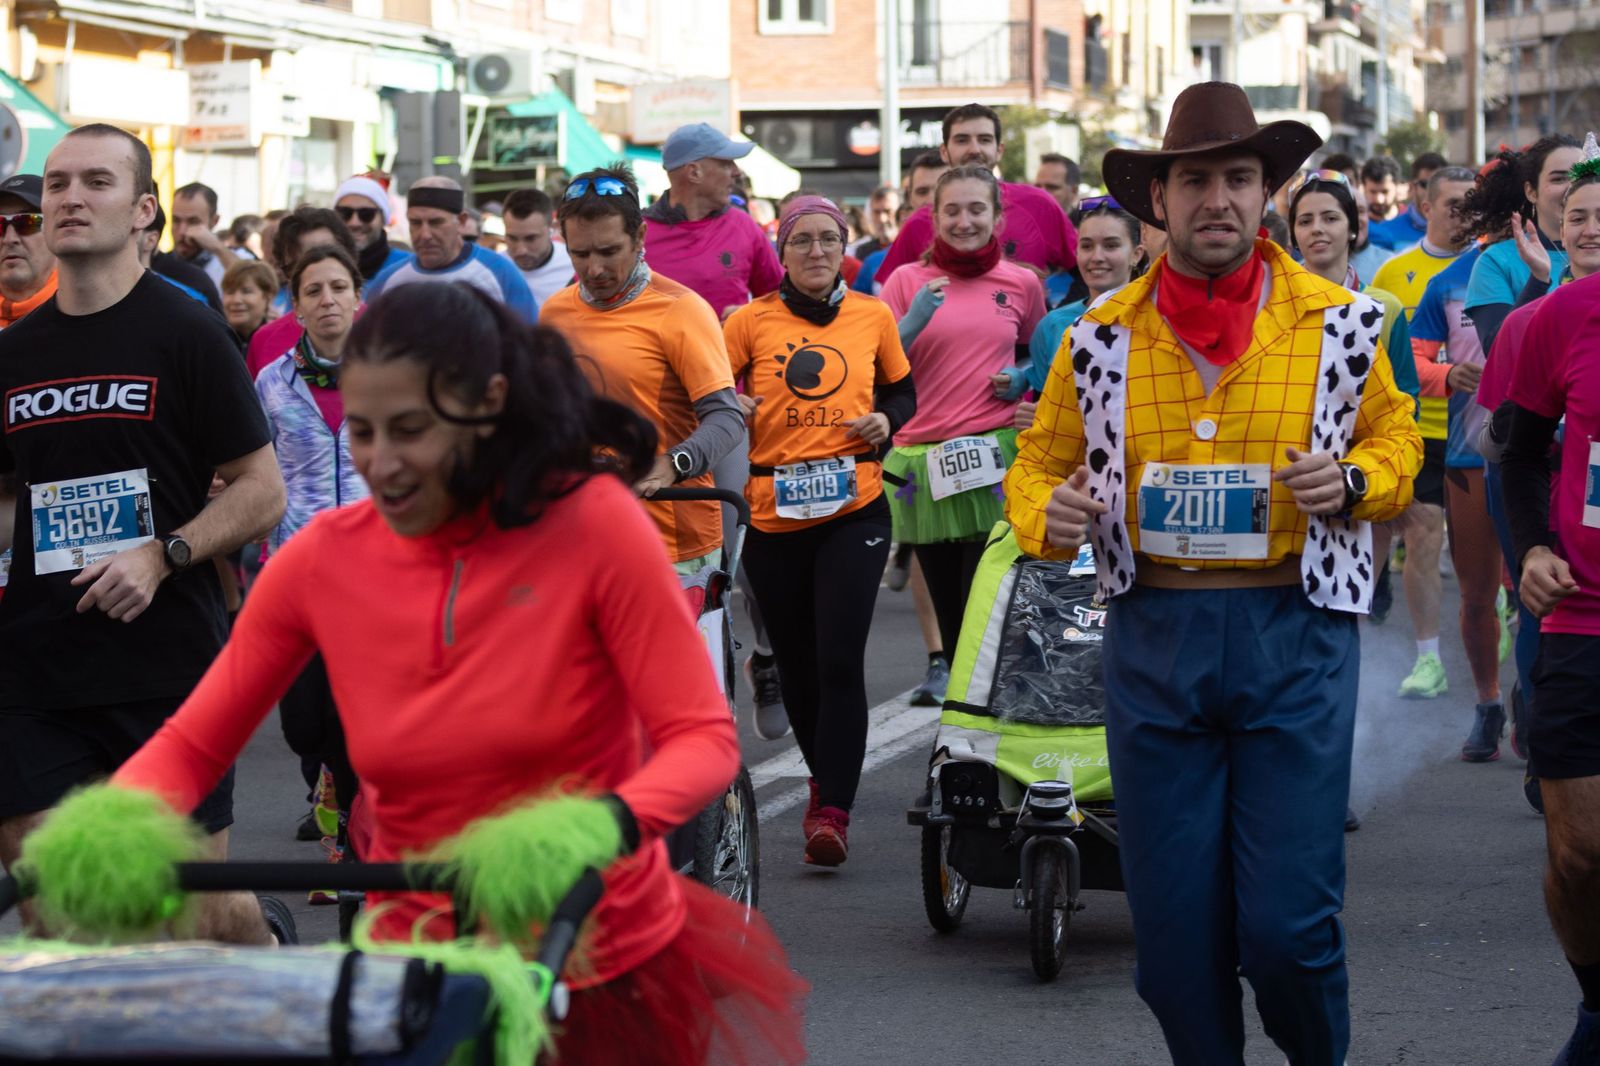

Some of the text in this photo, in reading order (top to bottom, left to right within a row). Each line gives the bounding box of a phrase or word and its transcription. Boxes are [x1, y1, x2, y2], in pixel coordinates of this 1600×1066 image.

[9, 383, 148, 424] ROGUE
[785, 407, 845, 428] B.612
[943, 439, 991, 453] SETEL
[795, 461, 848, 477] SETEL
[939, 448, 982, 478] 1509
[61, 478, 135, 501] SETEL
[785, 474, 838, 501] 3309
[1173, 470, 1256, 485] SETEL
[48, 499, 122, 542] 5692
[1164, 490, 1226, 526] 2011
